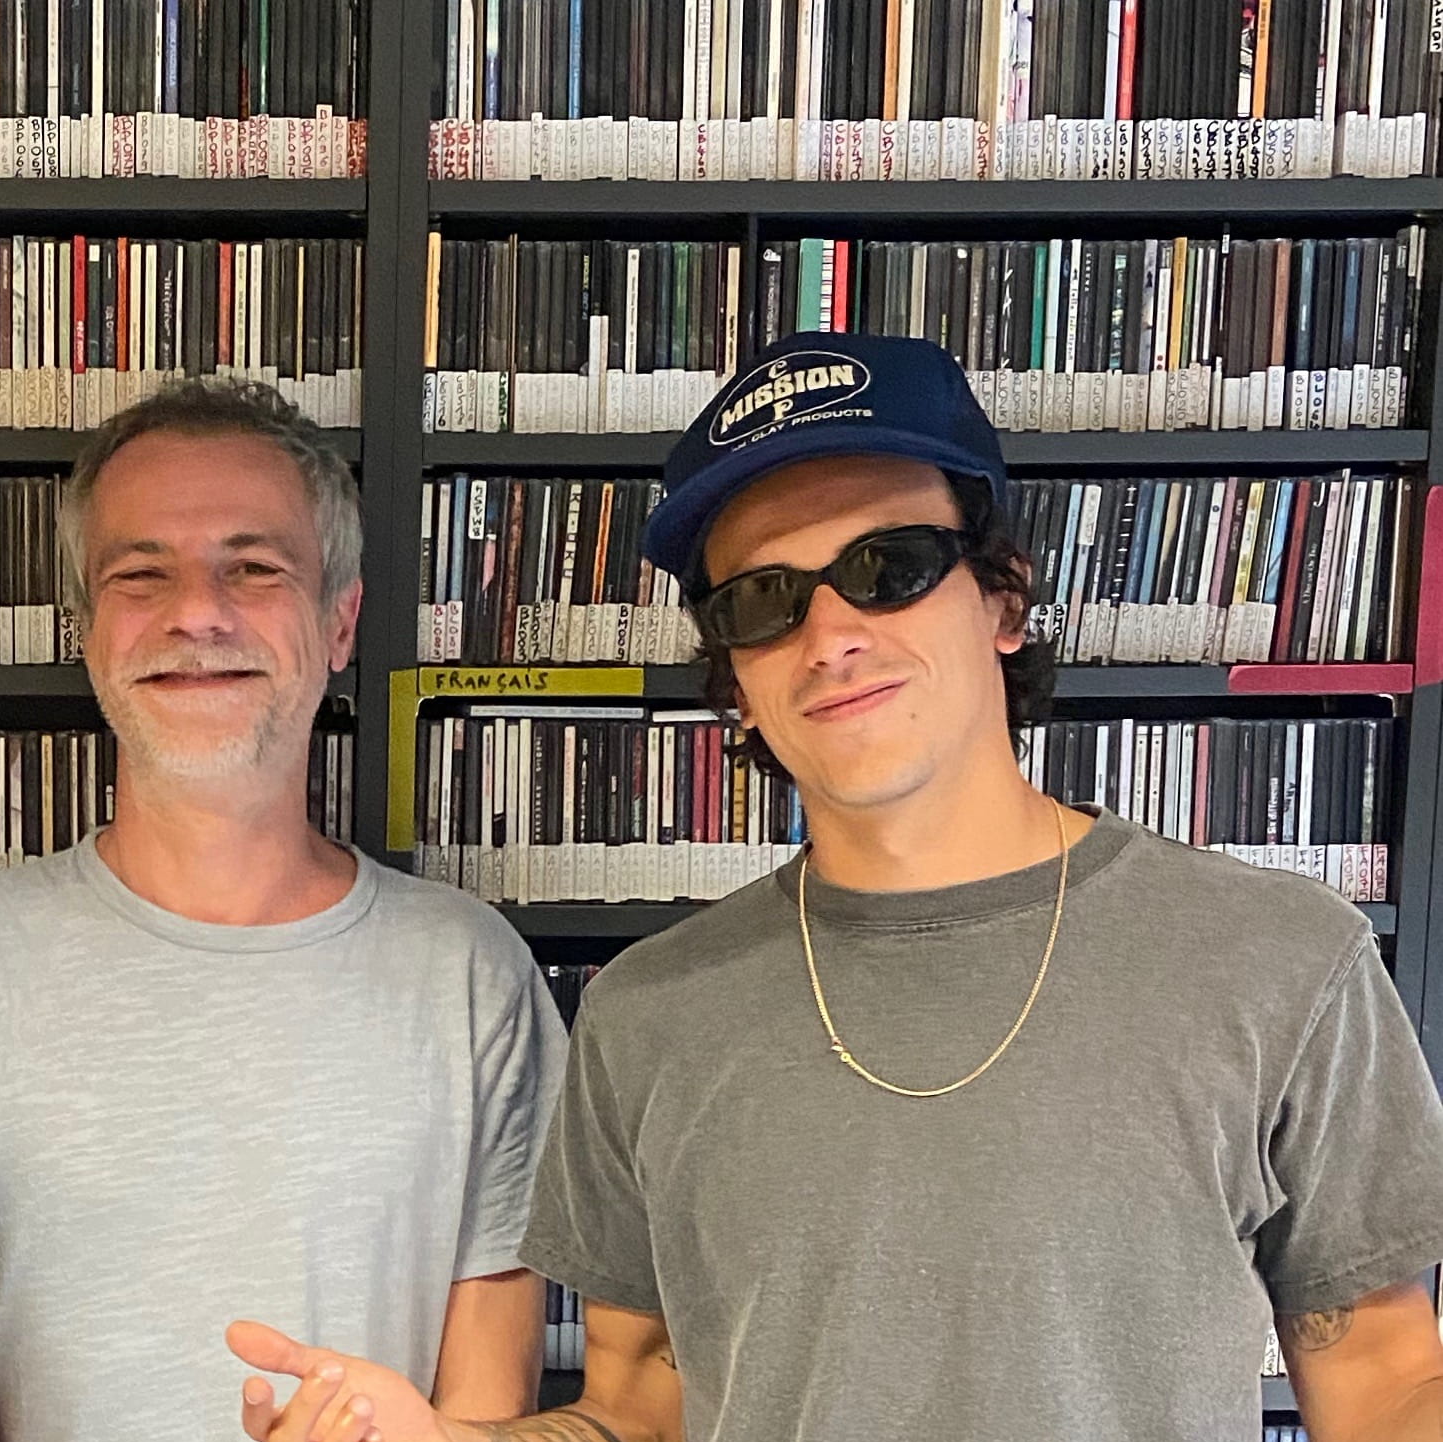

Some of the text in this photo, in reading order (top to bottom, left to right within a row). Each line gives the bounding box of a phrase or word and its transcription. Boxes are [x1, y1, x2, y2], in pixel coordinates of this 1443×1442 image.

[30, 118, 42, 178] BP067
[719, 364, 856, 436] MISSION
[750, 407, 875, 444] CLAY PRODUCTS
[435, 671, 549, 693] FRANÇAIS
